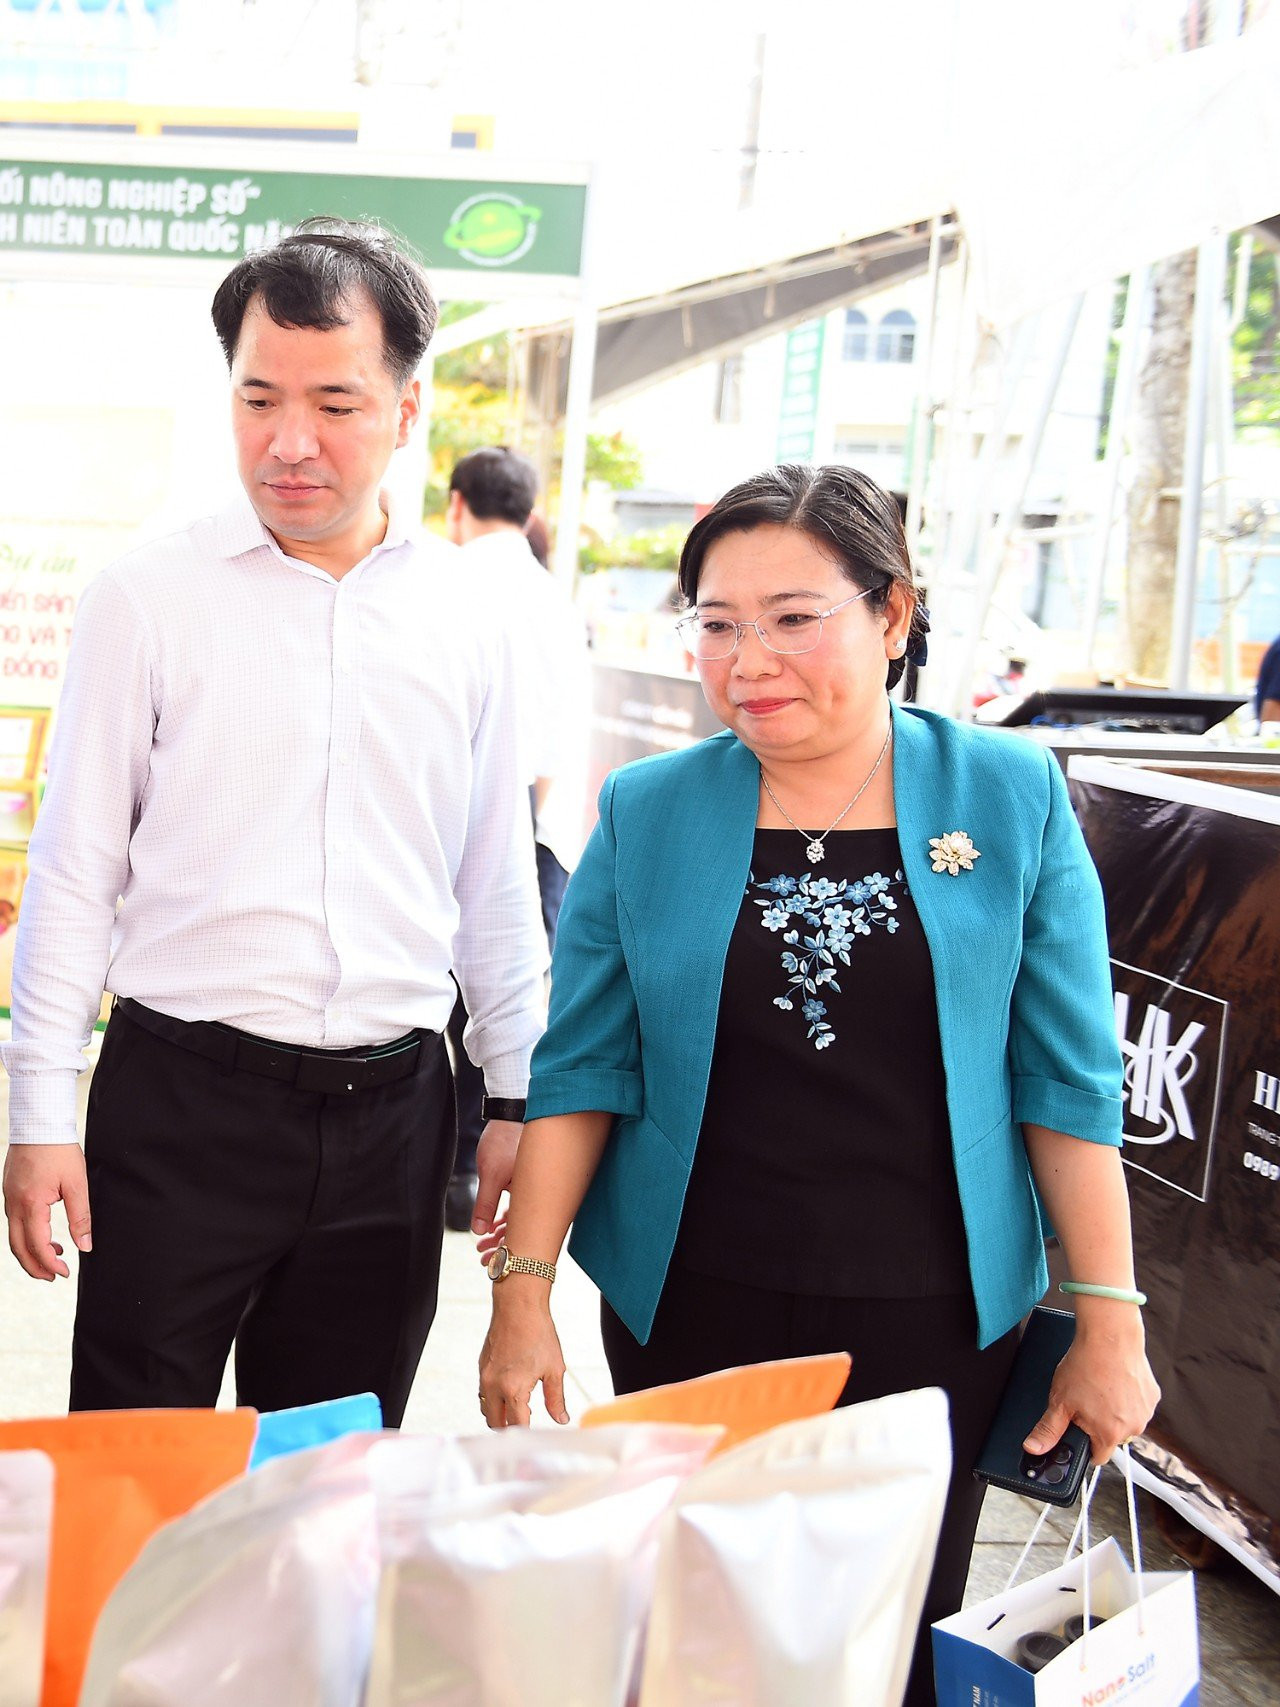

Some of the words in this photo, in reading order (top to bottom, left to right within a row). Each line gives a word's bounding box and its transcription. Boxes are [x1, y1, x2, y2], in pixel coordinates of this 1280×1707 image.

[29, 171, 103, 209] NÔNG
[107, 177, 206, 217] NGHIỆP
[23, 209, 87, 246] NIÊN
[92, 213, 163, 249] TOÀN
[168, 215, 239, 252] QUỐC
[1127, 1652, 1155, 1683] Salt
